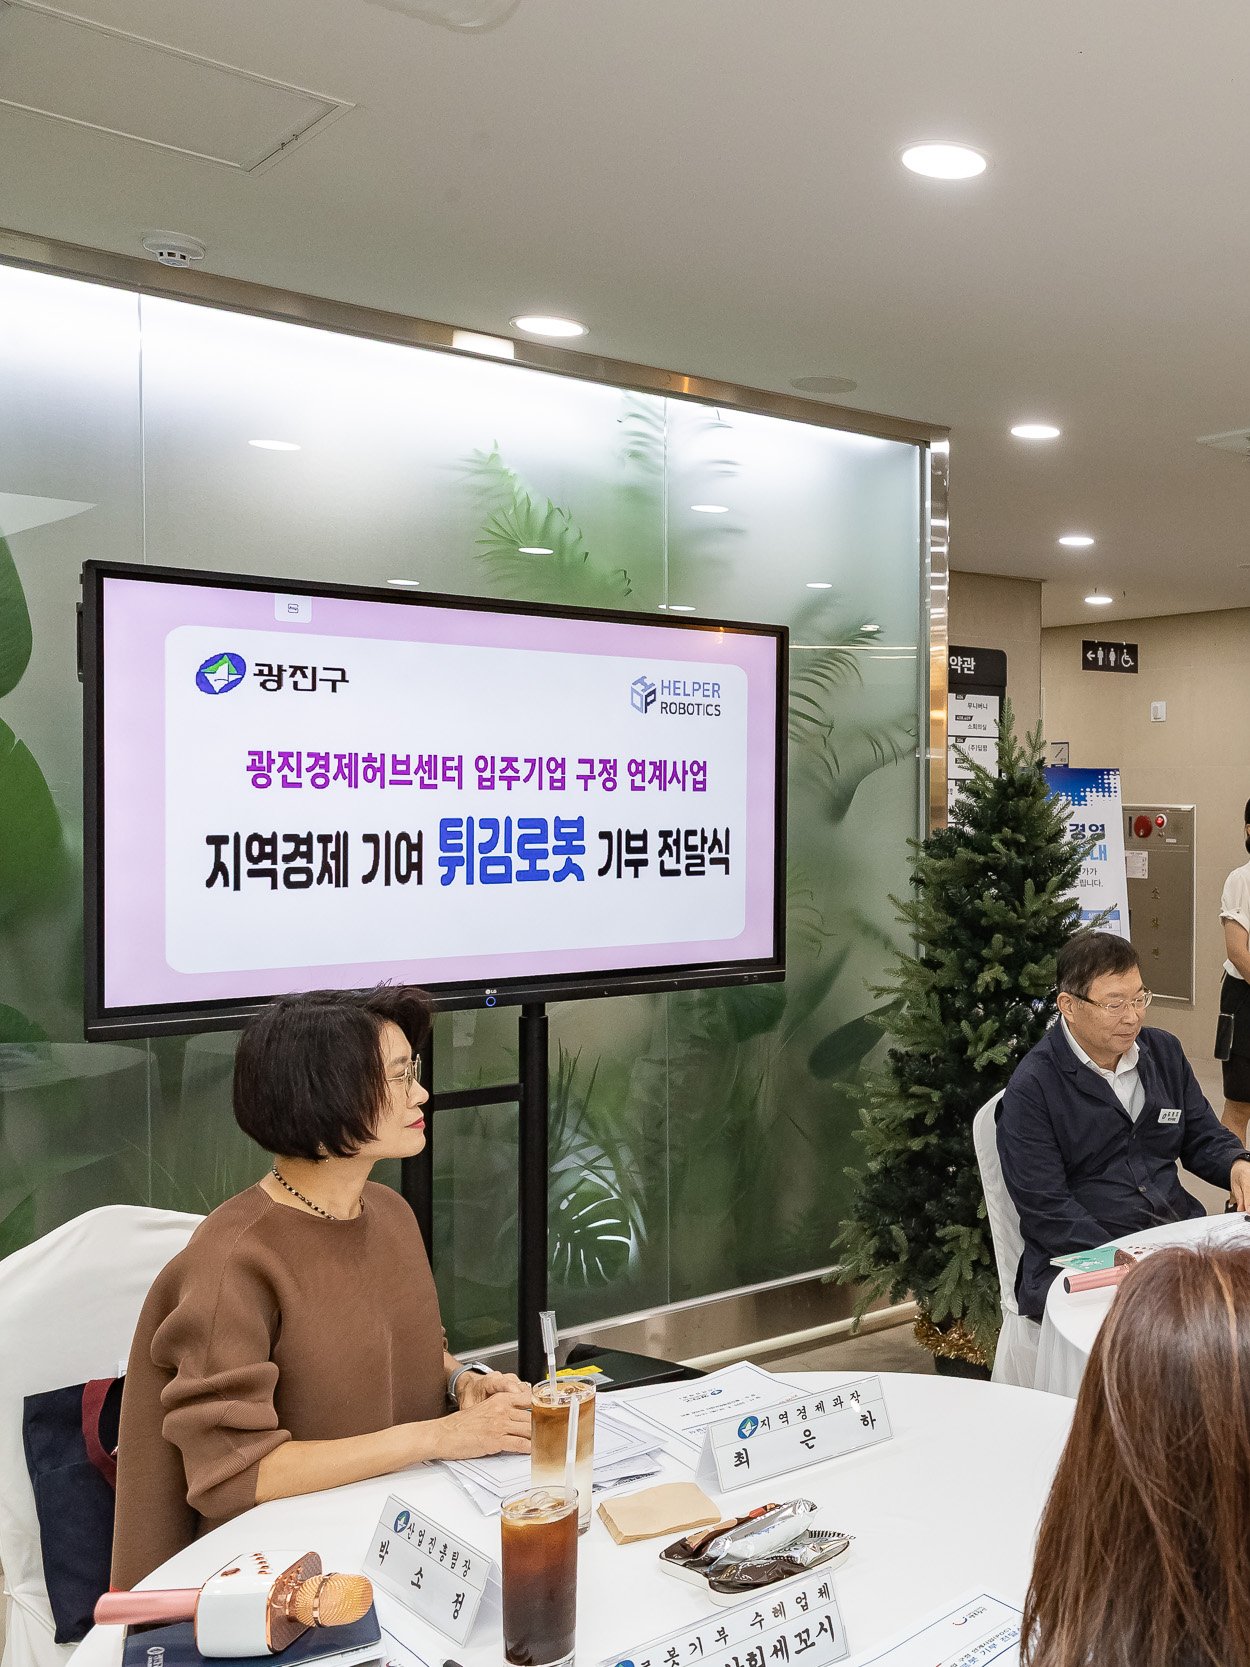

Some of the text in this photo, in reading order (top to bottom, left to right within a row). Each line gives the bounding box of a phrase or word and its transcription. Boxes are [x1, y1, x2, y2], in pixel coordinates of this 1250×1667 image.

[253, 662, 350, 694] 광진구
[949, 655, 976, 675] 약관
[660, 679, 721, 699] HELPER
[660, 701, 721, 717] ROBOTICS
[967, 723, 987, 731] 소회의실
[245, 749, 707, 793] 광진경제허브센터 입주기업 구정 연계사업
[205, 815, 730, 892] 지역경제 기여 튀김로봇 기부 전달식
[406, 1521, 472, 1578] 산업진흥팀장
